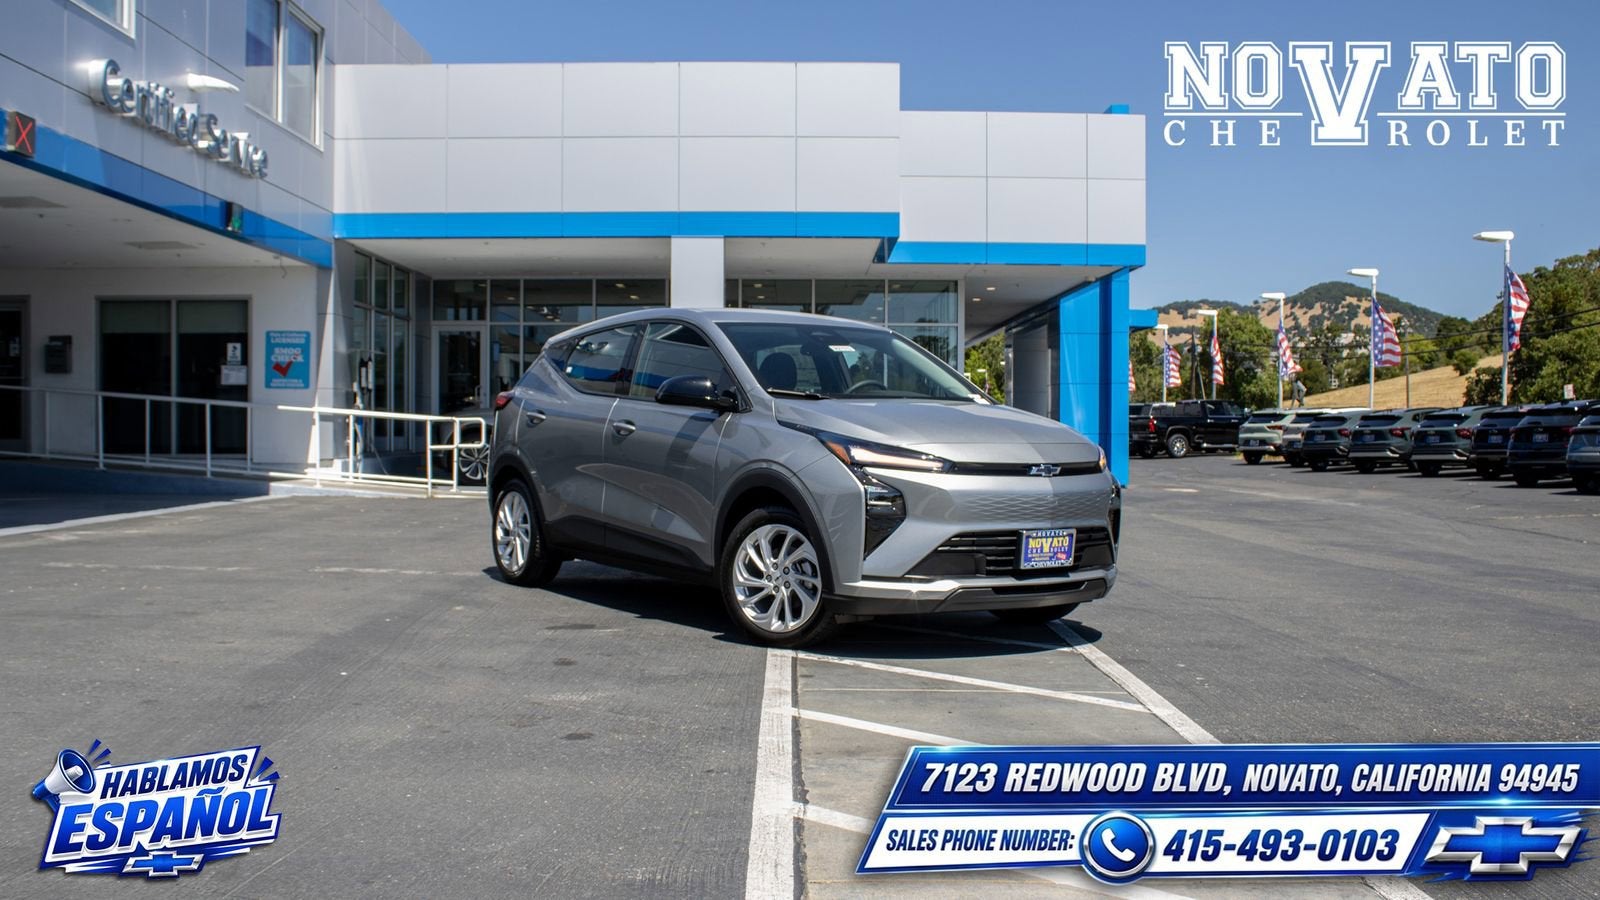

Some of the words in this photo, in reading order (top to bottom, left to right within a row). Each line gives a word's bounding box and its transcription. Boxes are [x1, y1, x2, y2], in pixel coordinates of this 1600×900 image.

[91, 58, 200, 153] Certified
[201, 113, 268, 178] Service
[273, 347, 302, 355] SMOG
[1028, 536, 1069, 553] NOVATO
